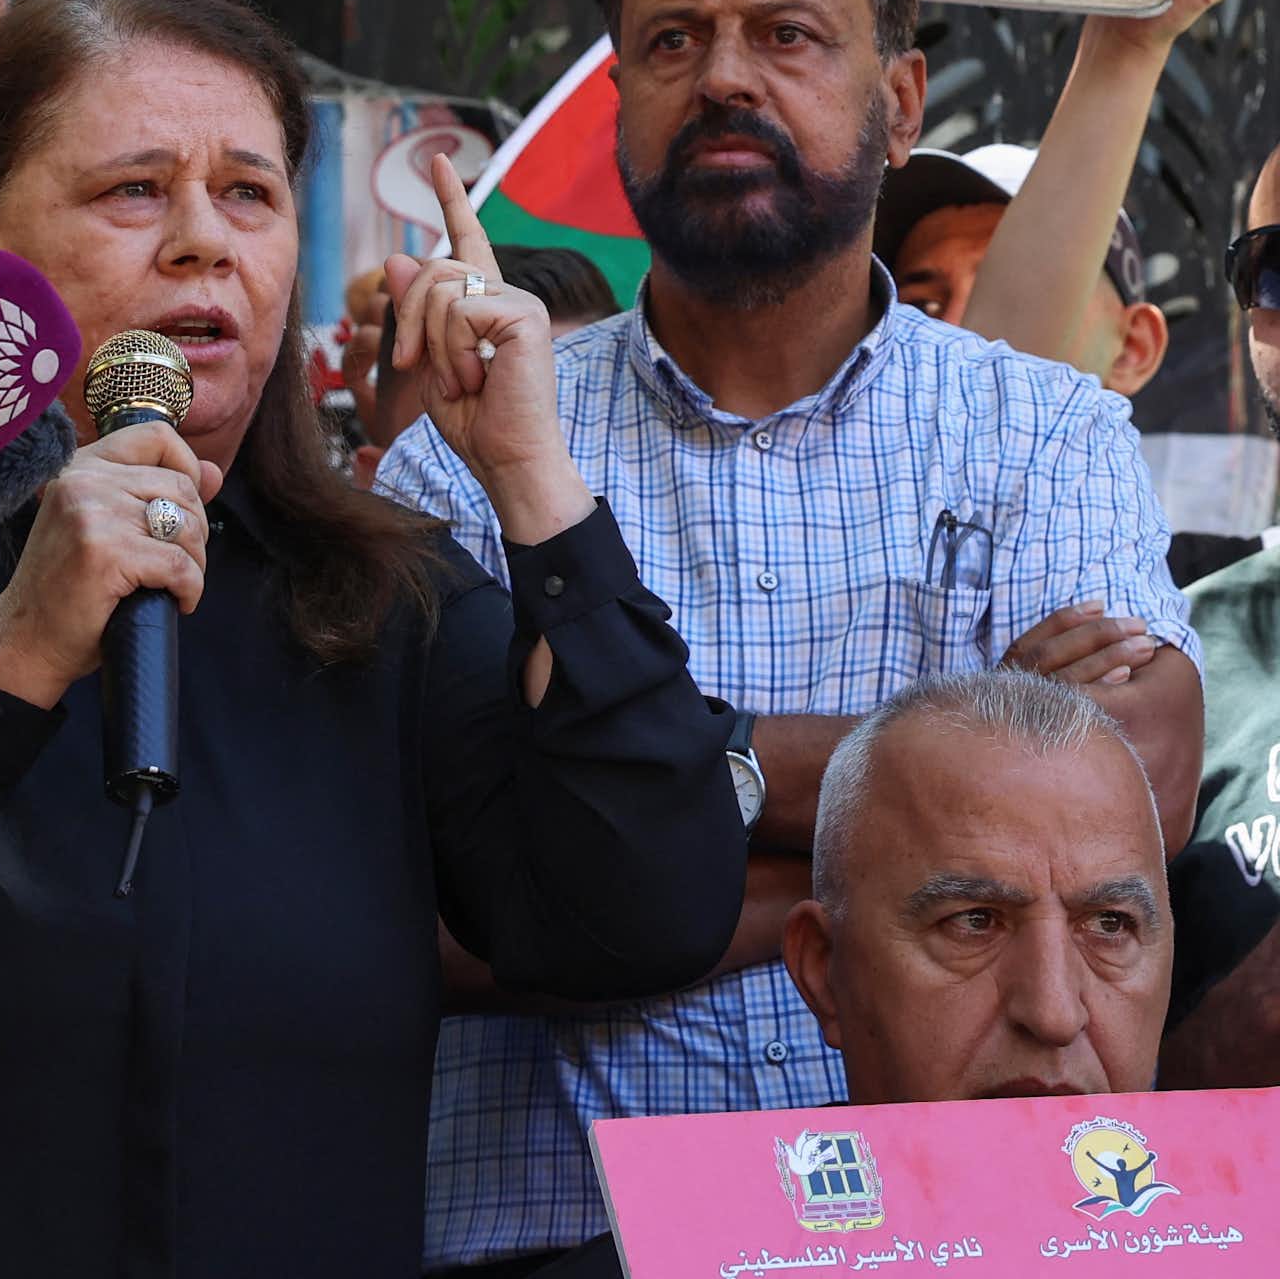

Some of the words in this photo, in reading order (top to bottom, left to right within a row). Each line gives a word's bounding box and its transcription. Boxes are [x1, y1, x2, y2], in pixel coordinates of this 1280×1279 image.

[930, 1236, 983, 1267] نادي
[1040, 1224, 1120, 1258] الأسرى
[1124, 1225, 1184, 1254] شؤون
[1186, 1222, 1244, 1249] هيئة
[719, 1245, 846, 1279] الفلسطيني
[849, 1235, 925, 1270] الأسير
